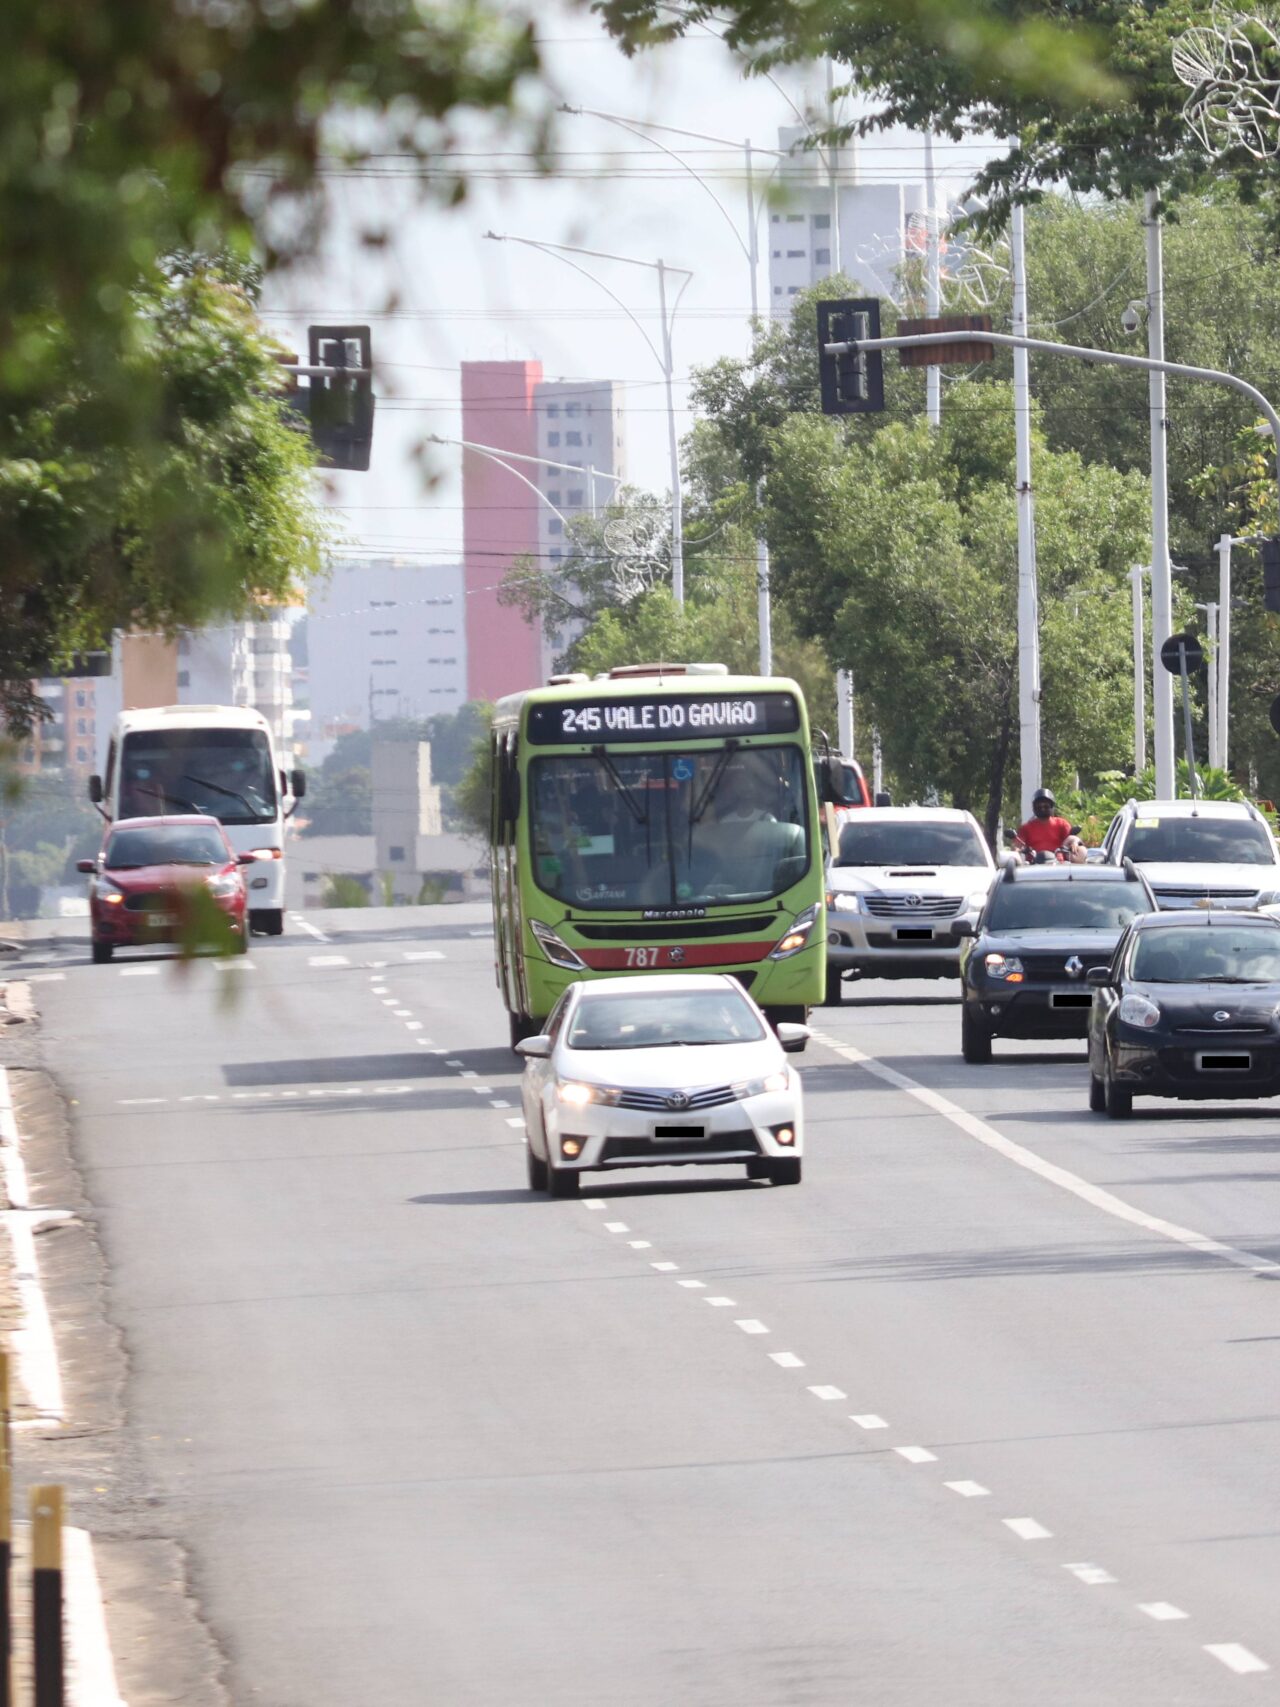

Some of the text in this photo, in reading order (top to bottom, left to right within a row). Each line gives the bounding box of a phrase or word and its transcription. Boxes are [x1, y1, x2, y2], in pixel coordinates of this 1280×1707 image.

[562, 701, 756, 732] 245 VALE DO GAVIÃO
[643, 909, 705, 918] Marcopolo
[624, 948, 659, 966] 787
